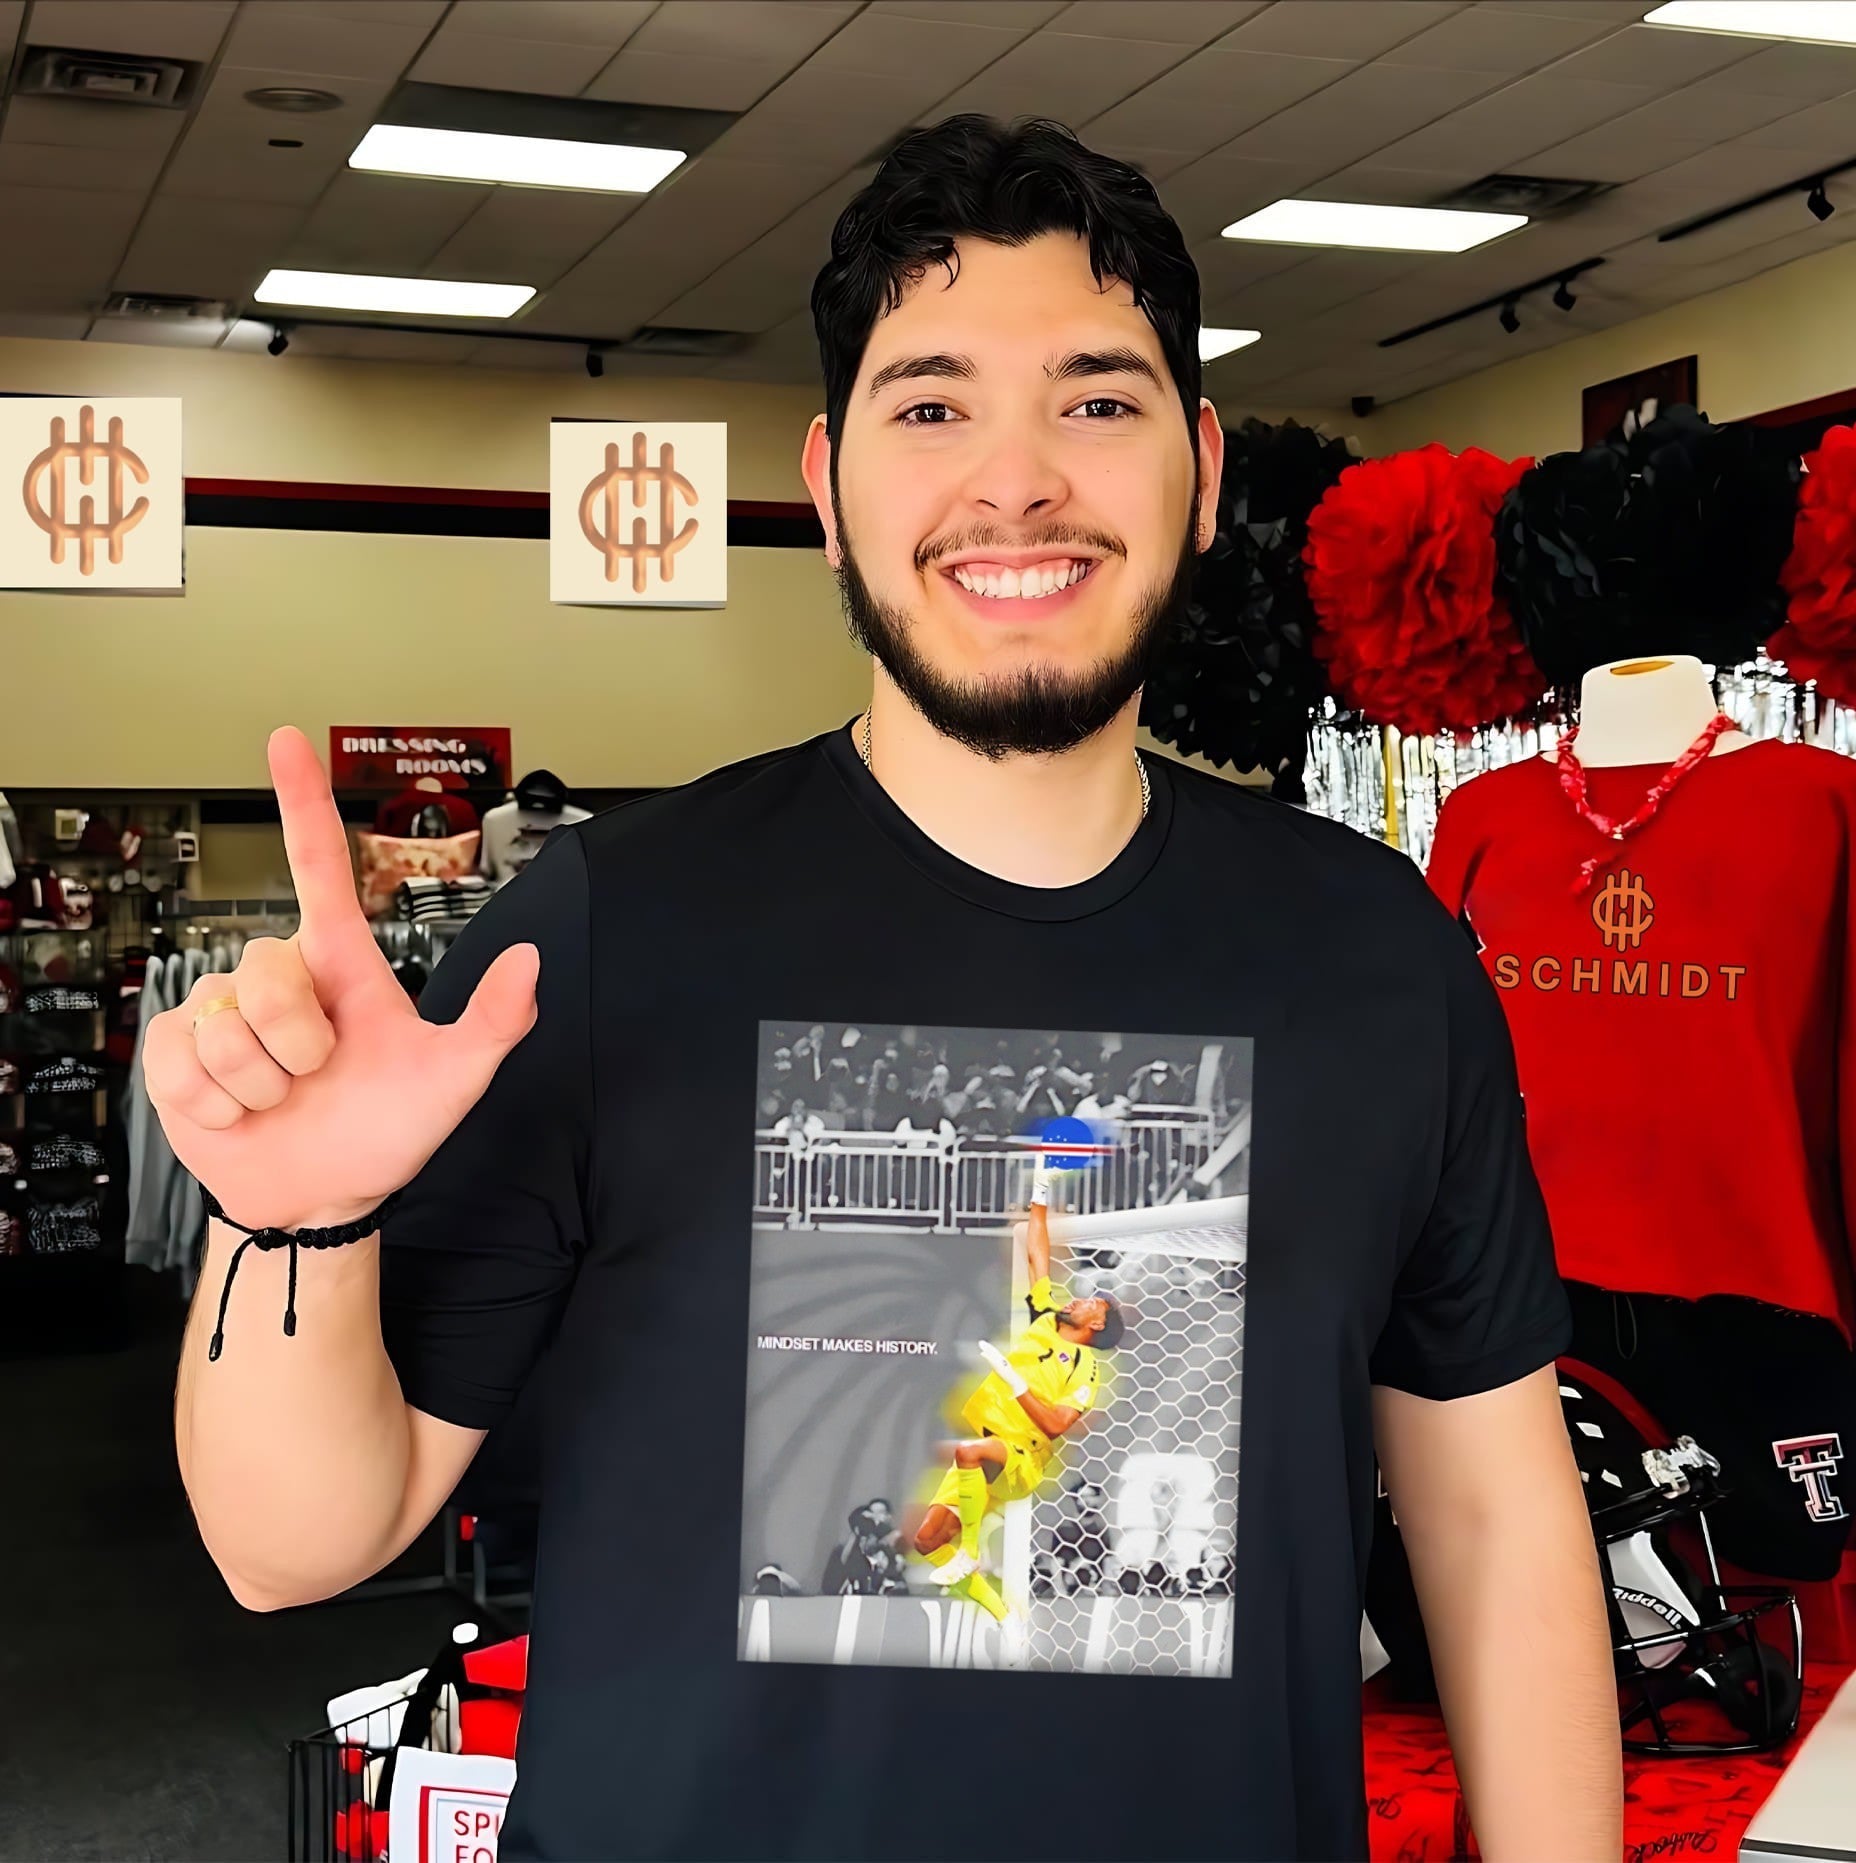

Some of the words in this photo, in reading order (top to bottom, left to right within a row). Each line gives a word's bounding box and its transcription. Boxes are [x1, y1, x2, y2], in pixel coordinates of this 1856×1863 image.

[342, 737, 466, 753] DRESSING
[396, 758, 486, 775] ROOMS
[1494, 953, 1746, 1000] SCHMIDT
[757, 1336, 821, 1350] MINDSET
[822, 1338, 873, 1353] MAKES
[876, 1340, 938, 1355] HISTORY.
